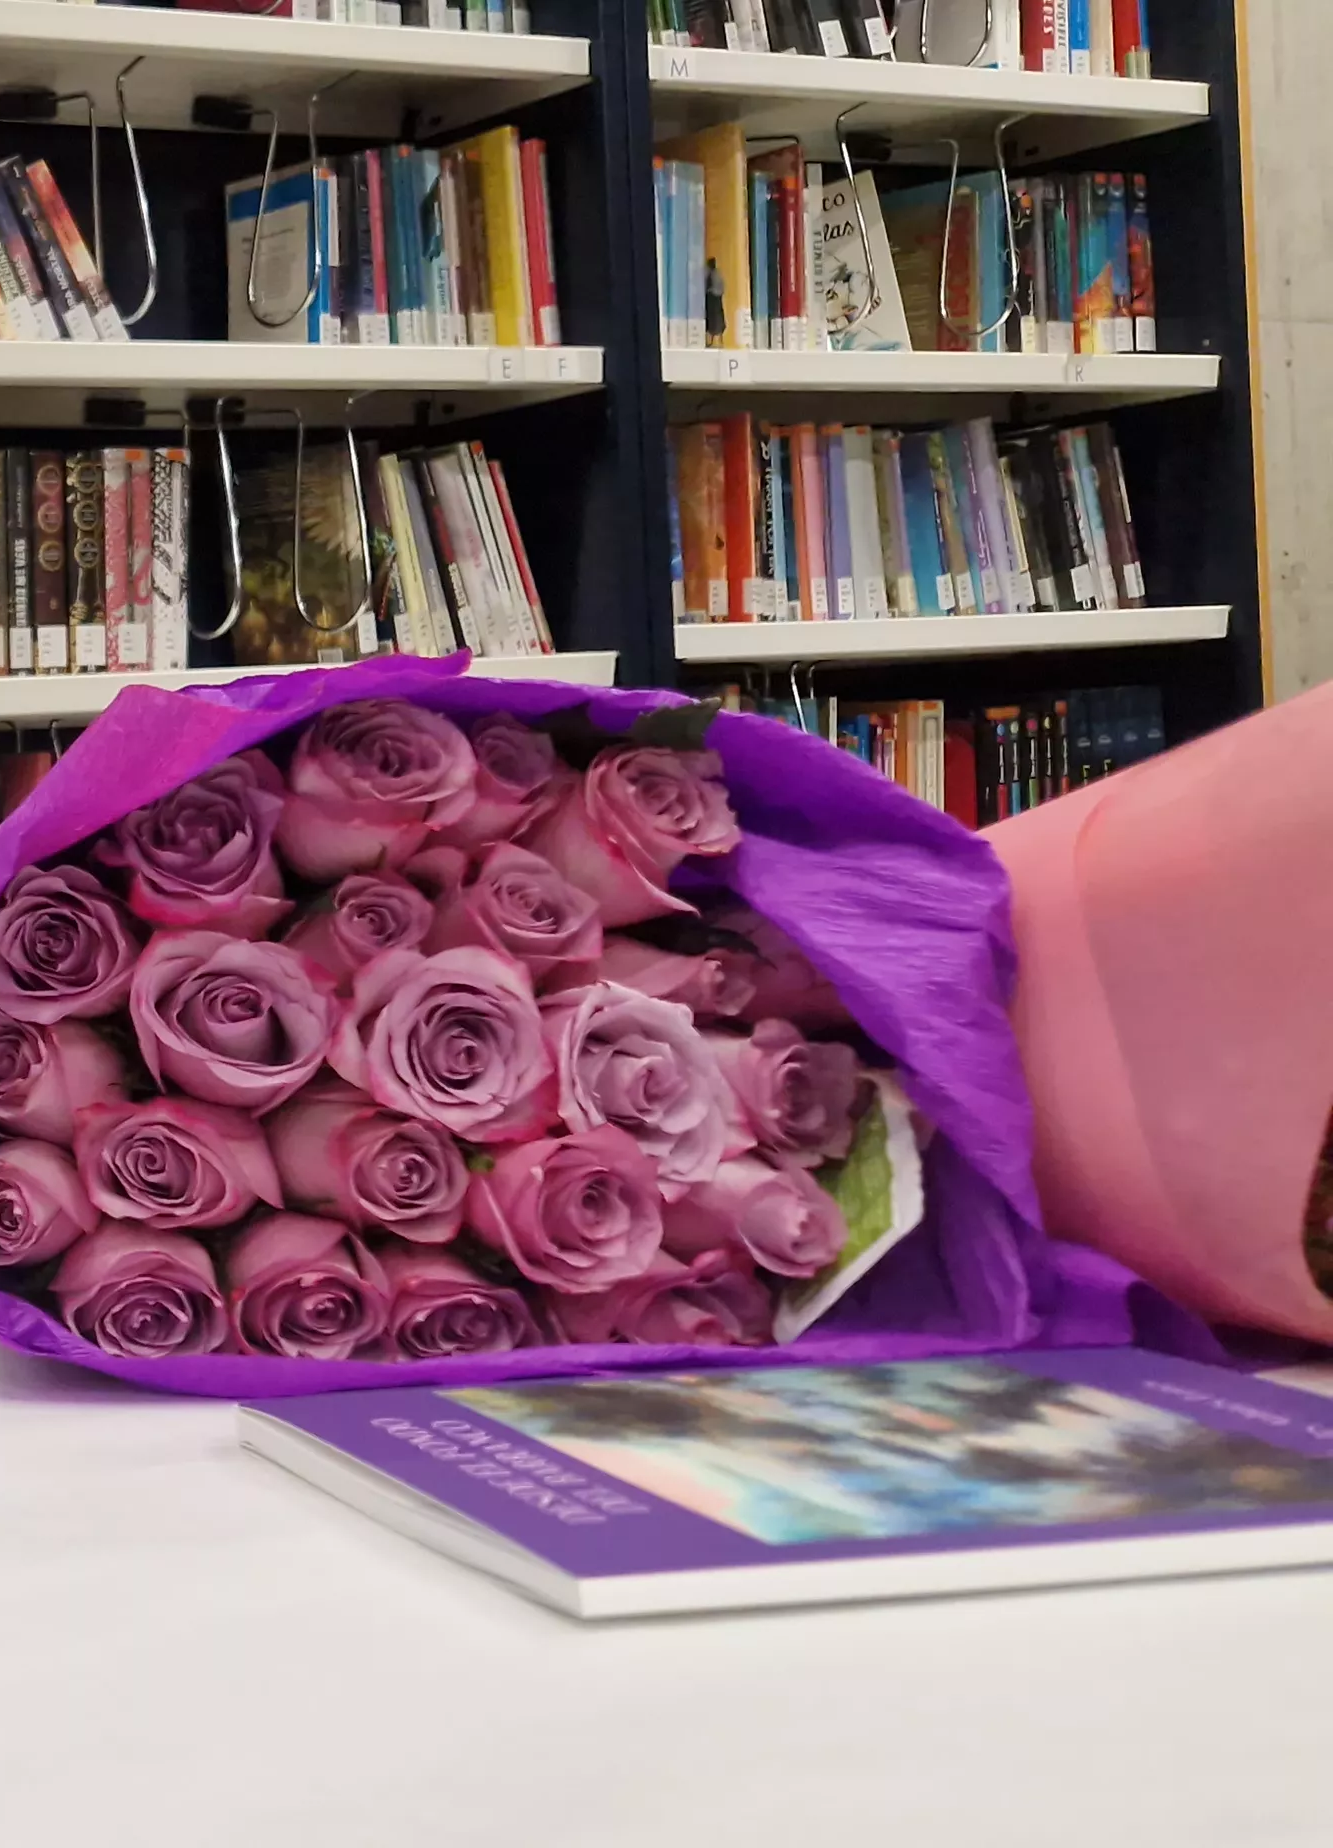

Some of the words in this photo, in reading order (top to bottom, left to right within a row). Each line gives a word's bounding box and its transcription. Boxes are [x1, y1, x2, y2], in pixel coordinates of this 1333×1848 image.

[670, 58, 692, 78] M
[502, 358, 513, 379] E
[559, 358, 569, 378] F
[728, 359, 739, 378] P
[1074, 363, 1086, 382] R
